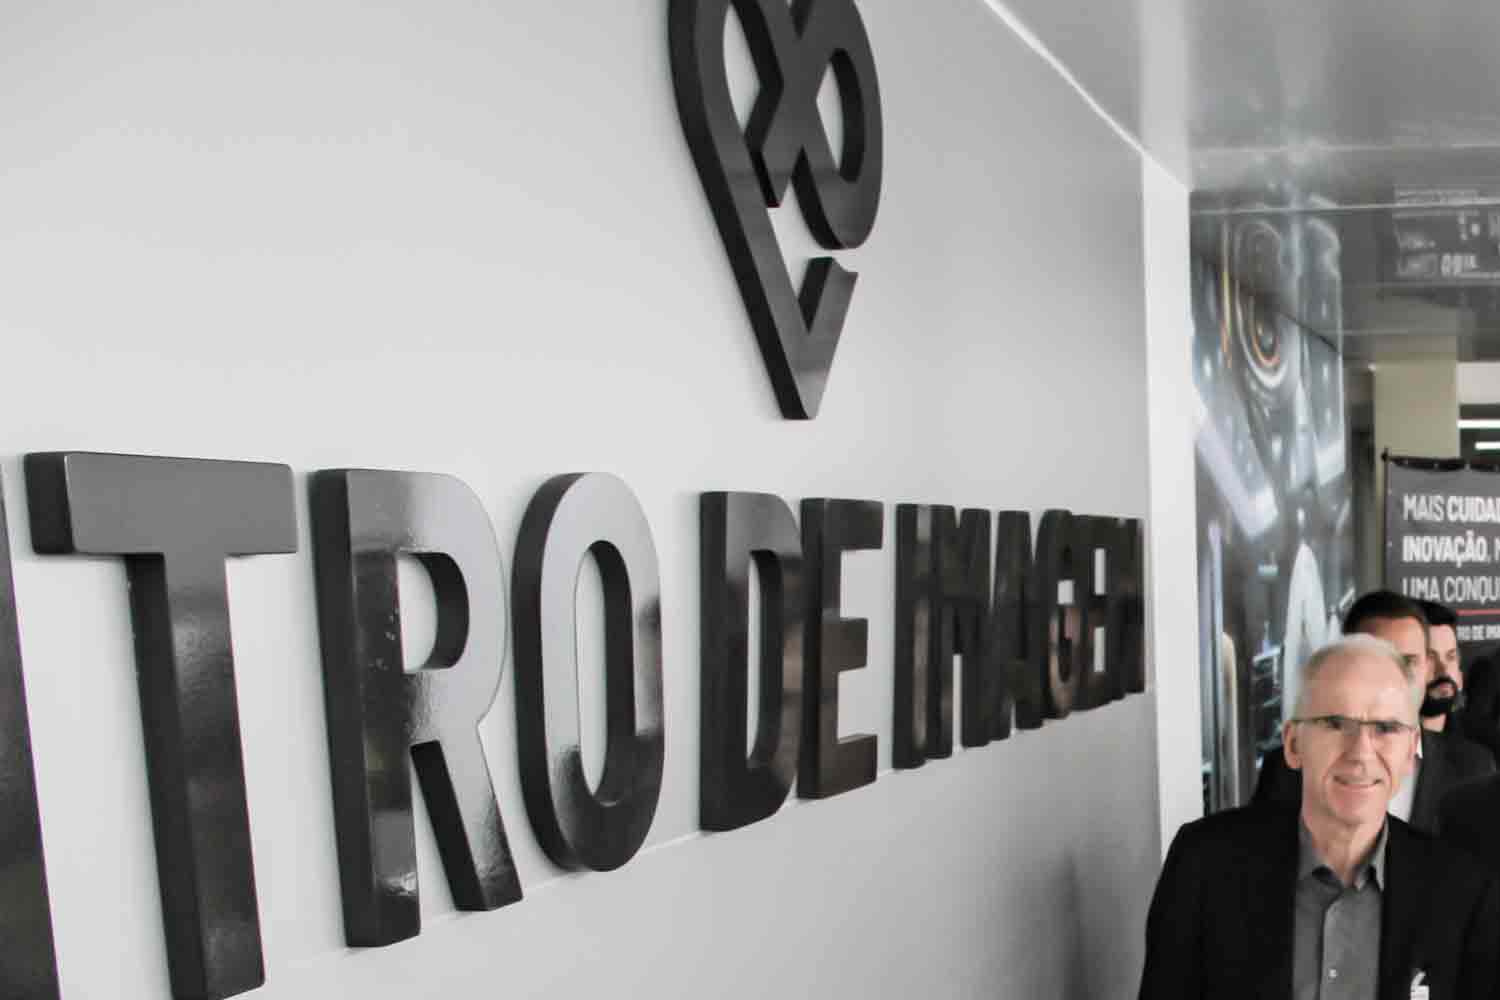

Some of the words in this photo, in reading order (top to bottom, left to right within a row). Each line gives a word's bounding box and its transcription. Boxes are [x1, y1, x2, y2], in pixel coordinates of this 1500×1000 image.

[1402, 494, 1445, 521] MAIS
[1402, 530, 1492, 568] INOVAÇÃO,
[1402, 576, 1441, 601] UMA
[699, 490, 884, 833] DE
